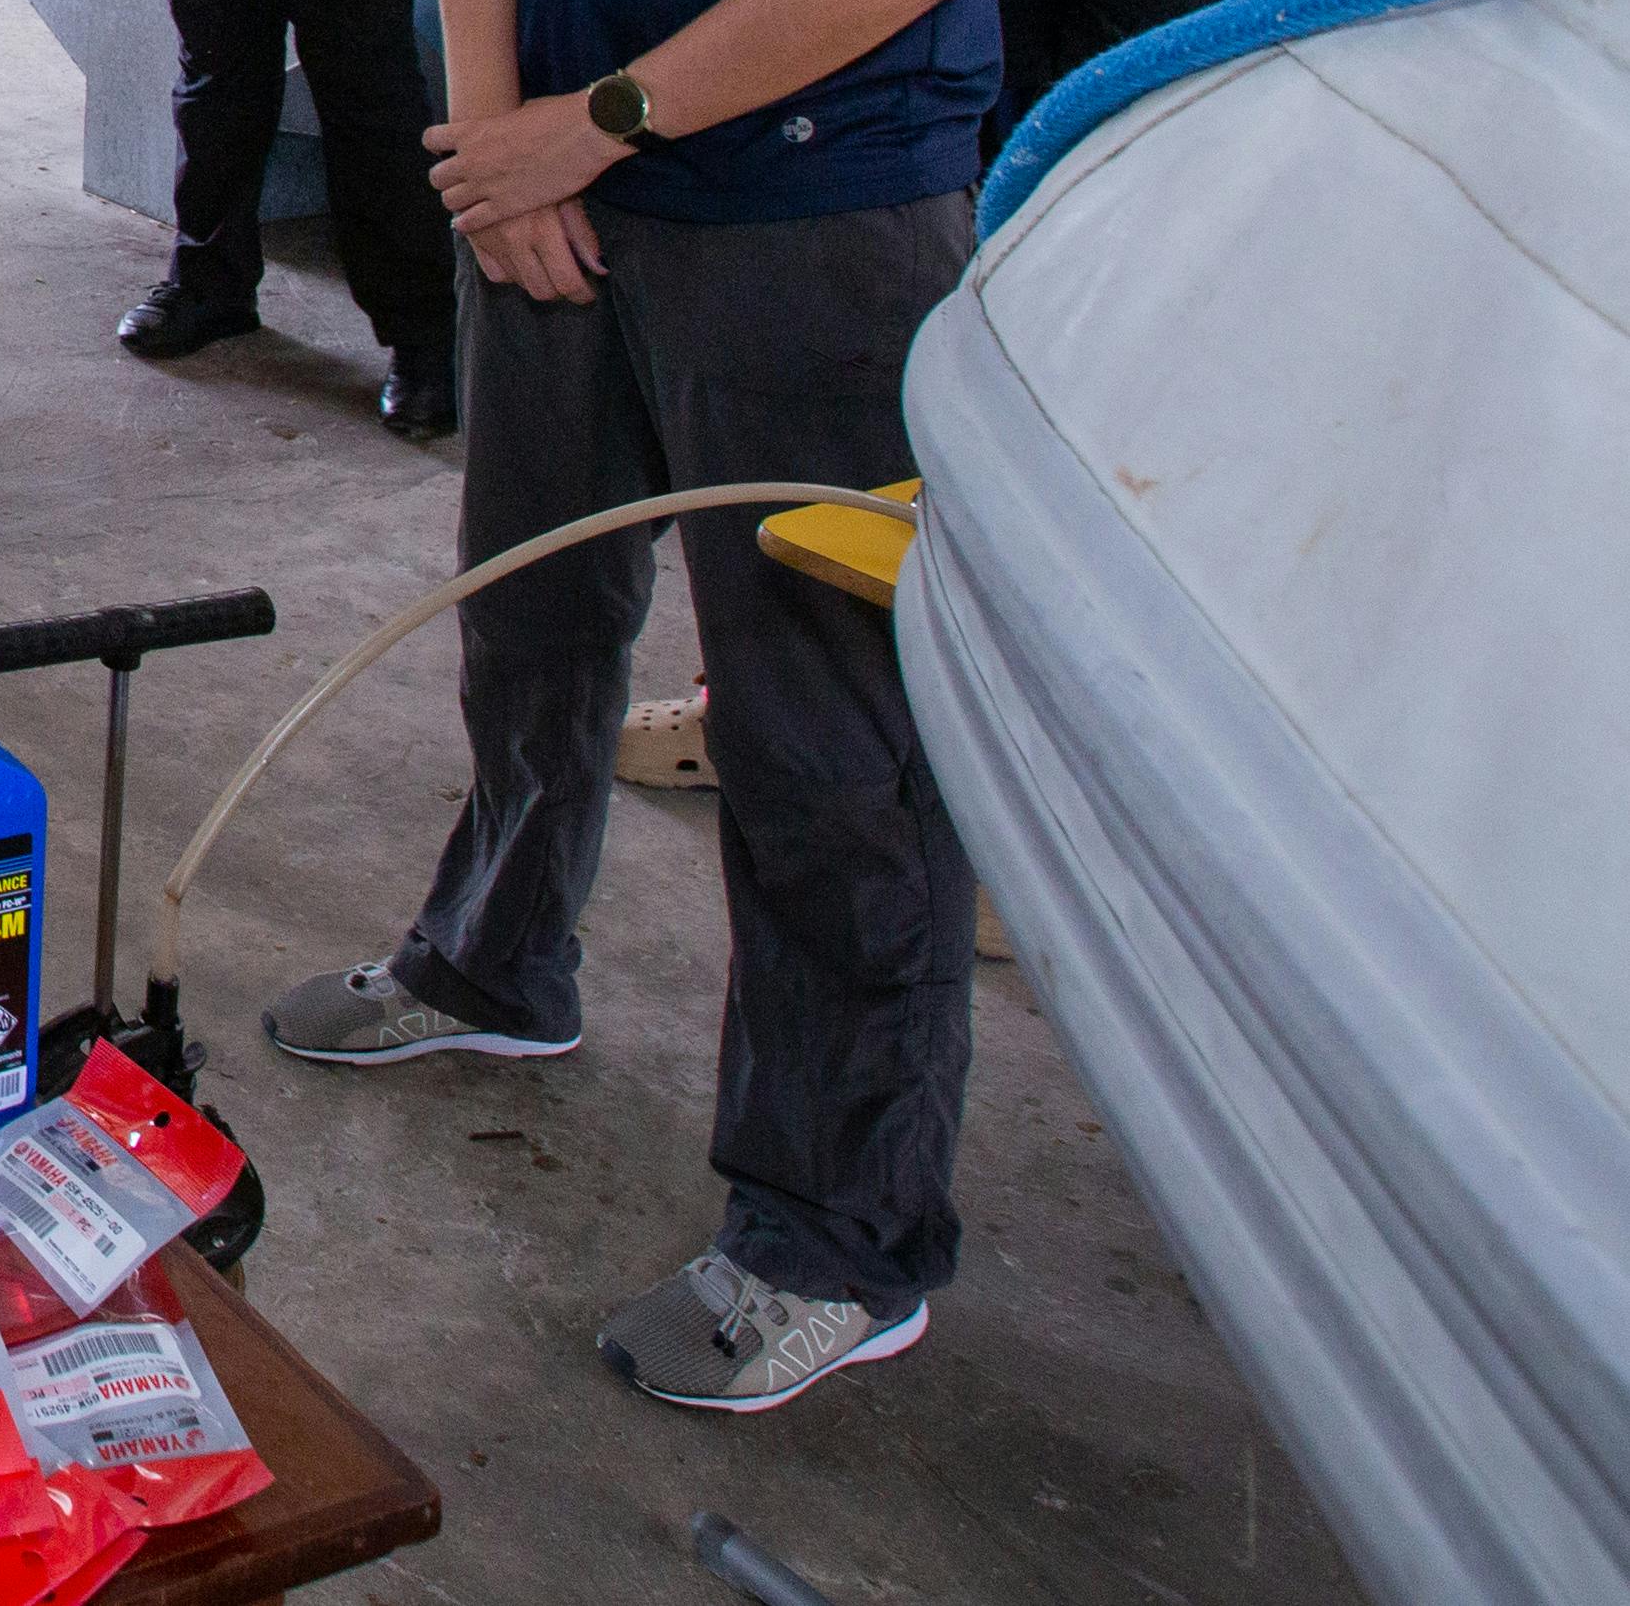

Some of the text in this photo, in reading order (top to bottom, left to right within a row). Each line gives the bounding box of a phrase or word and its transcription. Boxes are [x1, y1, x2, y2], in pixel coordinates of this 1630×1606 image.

[24, 1148, 68, 1187] YAMAHA
[77, 1217, 91, 1233] PC
[98, 1374, 174, 1400] YAMAHA
[96, 1434, 184, 1462] YAMAHA
